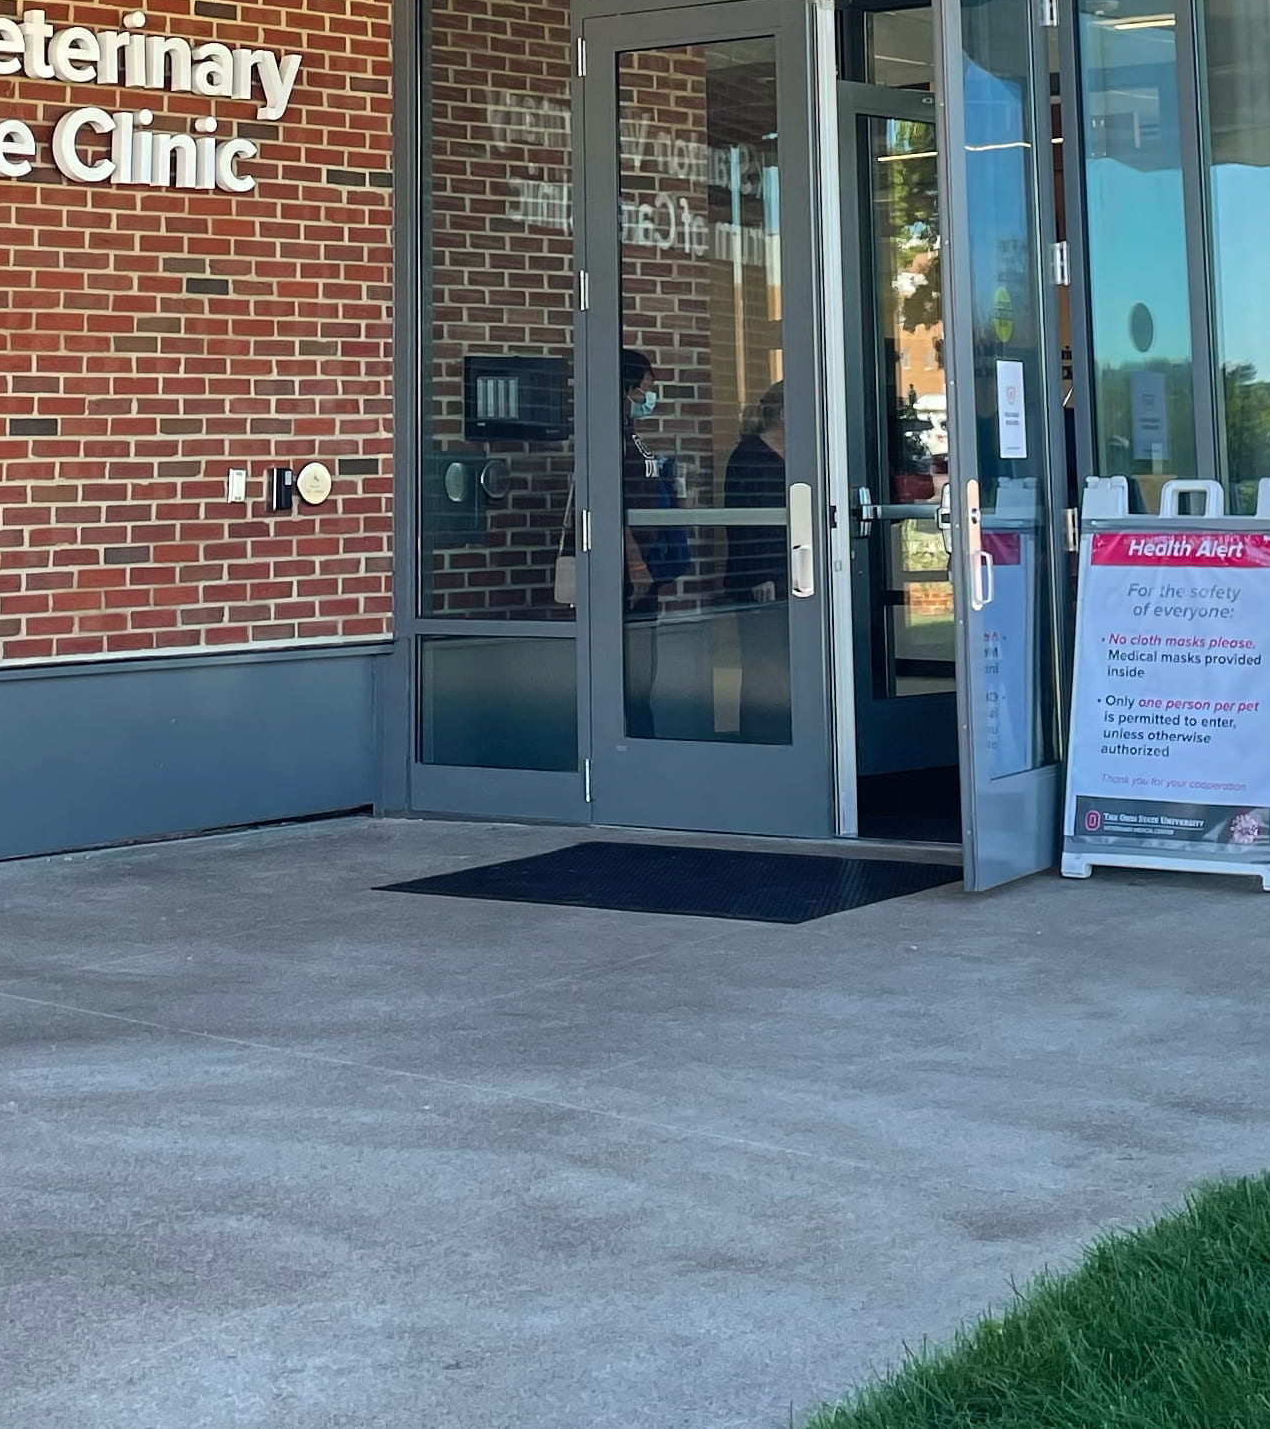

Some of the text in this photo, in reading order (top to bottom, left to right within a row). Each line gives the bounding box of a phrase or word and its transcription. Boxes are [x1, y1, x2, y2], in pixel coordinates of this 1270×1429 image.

[52, 106, 259, 193] Clinic
[1128, 539, 1244, 558] Health Alert
[1127, 583, 1241, 603] For the safety
[1133, 602, 1235, 621] of everyone:
[1108, 633, 1127, 645] No
[1130, 634, 1162, 647] cloth
[1165, 635, 1206, 648] masks
[1107, 649, 1262, 667] Medical masks provided
[1107, 666, 1145, 678] inside
[1105, 694, 1259, 714] Only one person per pet
[1104, 711, 1115, 722] is
[1118, 713, 1180, 726] permitted
[1184, 715, 1197, 727] to
[1103, 728, 1211, 744] unless otherwise
[1100, 744, 1170, 757] authorized
